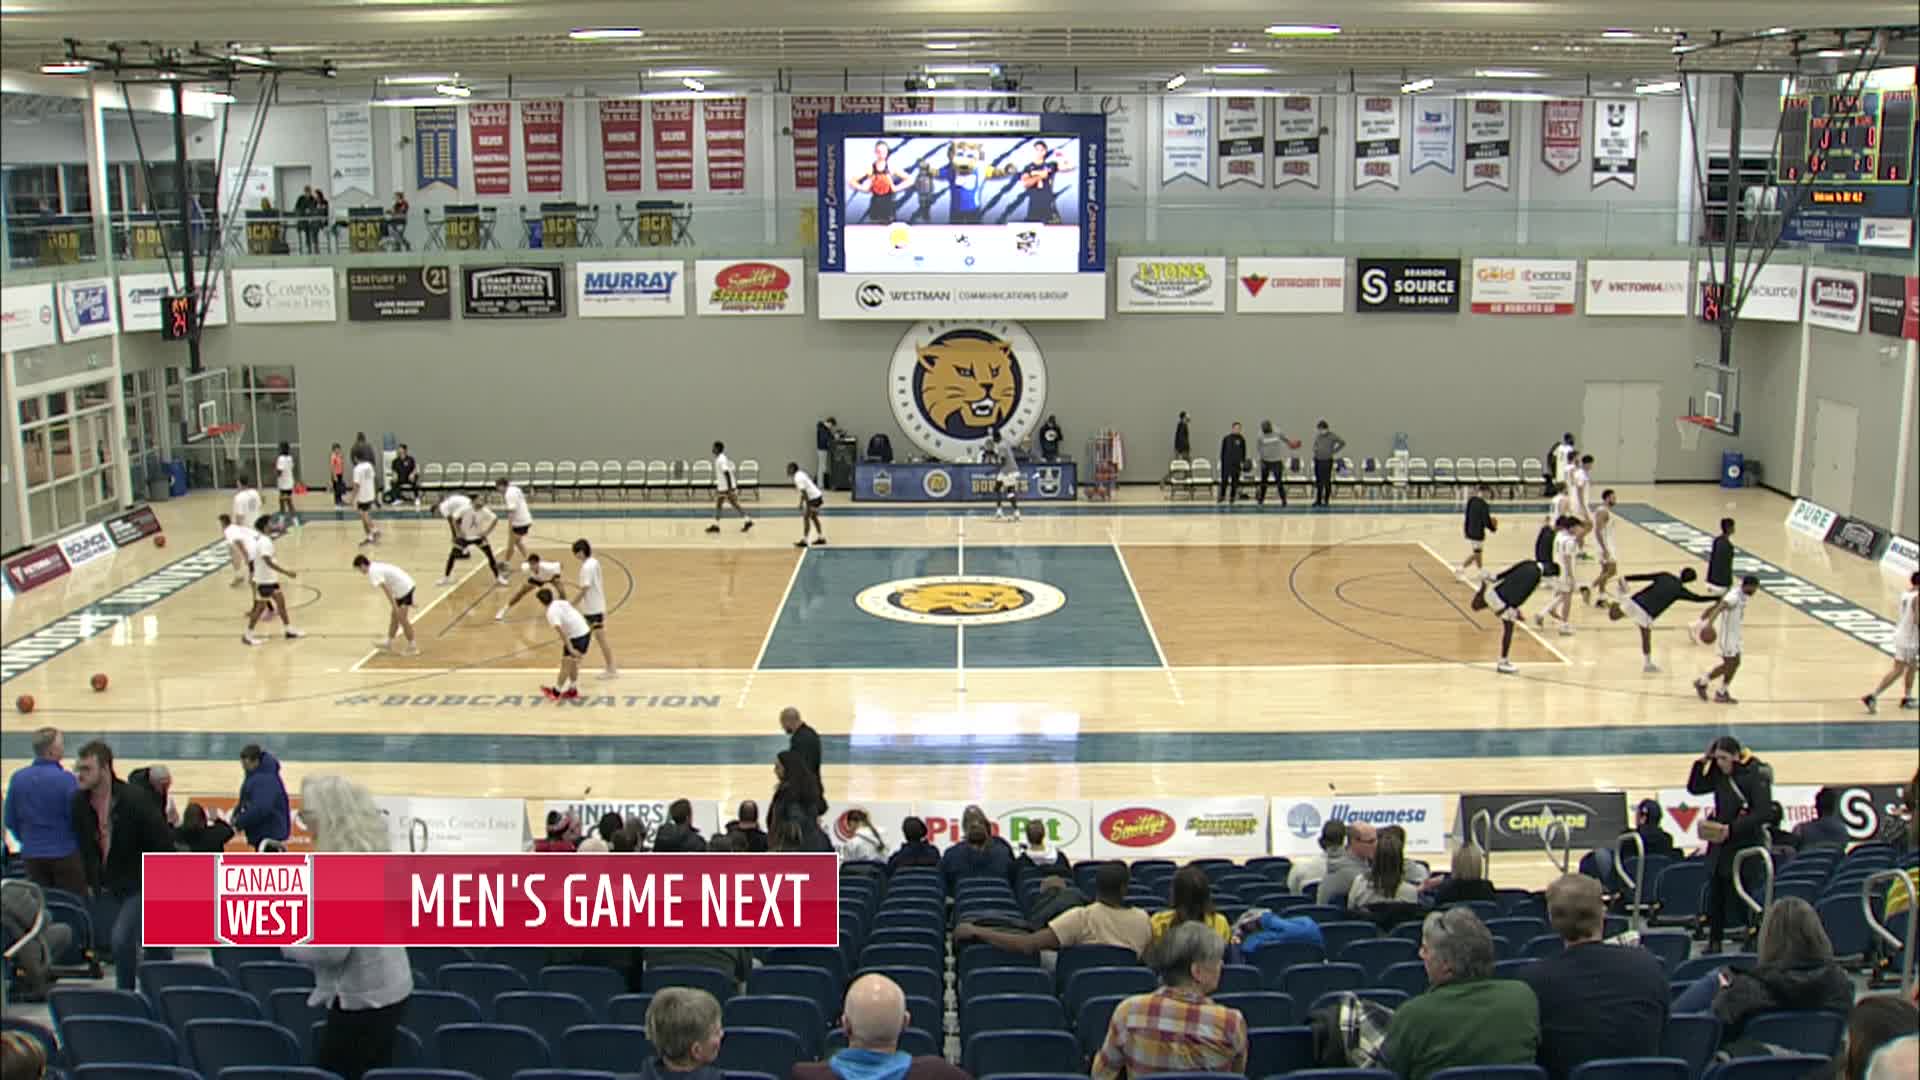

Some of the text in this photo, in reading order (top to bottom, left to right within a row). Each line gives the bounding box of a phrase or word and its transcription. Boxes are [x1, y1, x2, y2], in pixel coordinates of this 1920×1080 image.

[430, 268, 448, 286] 21
[1136, 261, 1207, 280] LYONS
[1404, 268, 1447, 278] BRANDON
[351, 274, 394, 285] CENTURY
[584, 271, 677, 291] MURRAY
[1394, 279, 1456, 294] SOURCE
[1608, 280, 1662, 293] VICTORIA
[889, 290, 1069, 301] WESTMAN COMMUNICATIONS GROUP
[1398, 295, 1450, 305] FOR SPORTS
[1795, 500, 1830, 529] PURE
[1010, 815, 1063, 842] Pt
[1110, 813, 1168, 842] Smitty's
